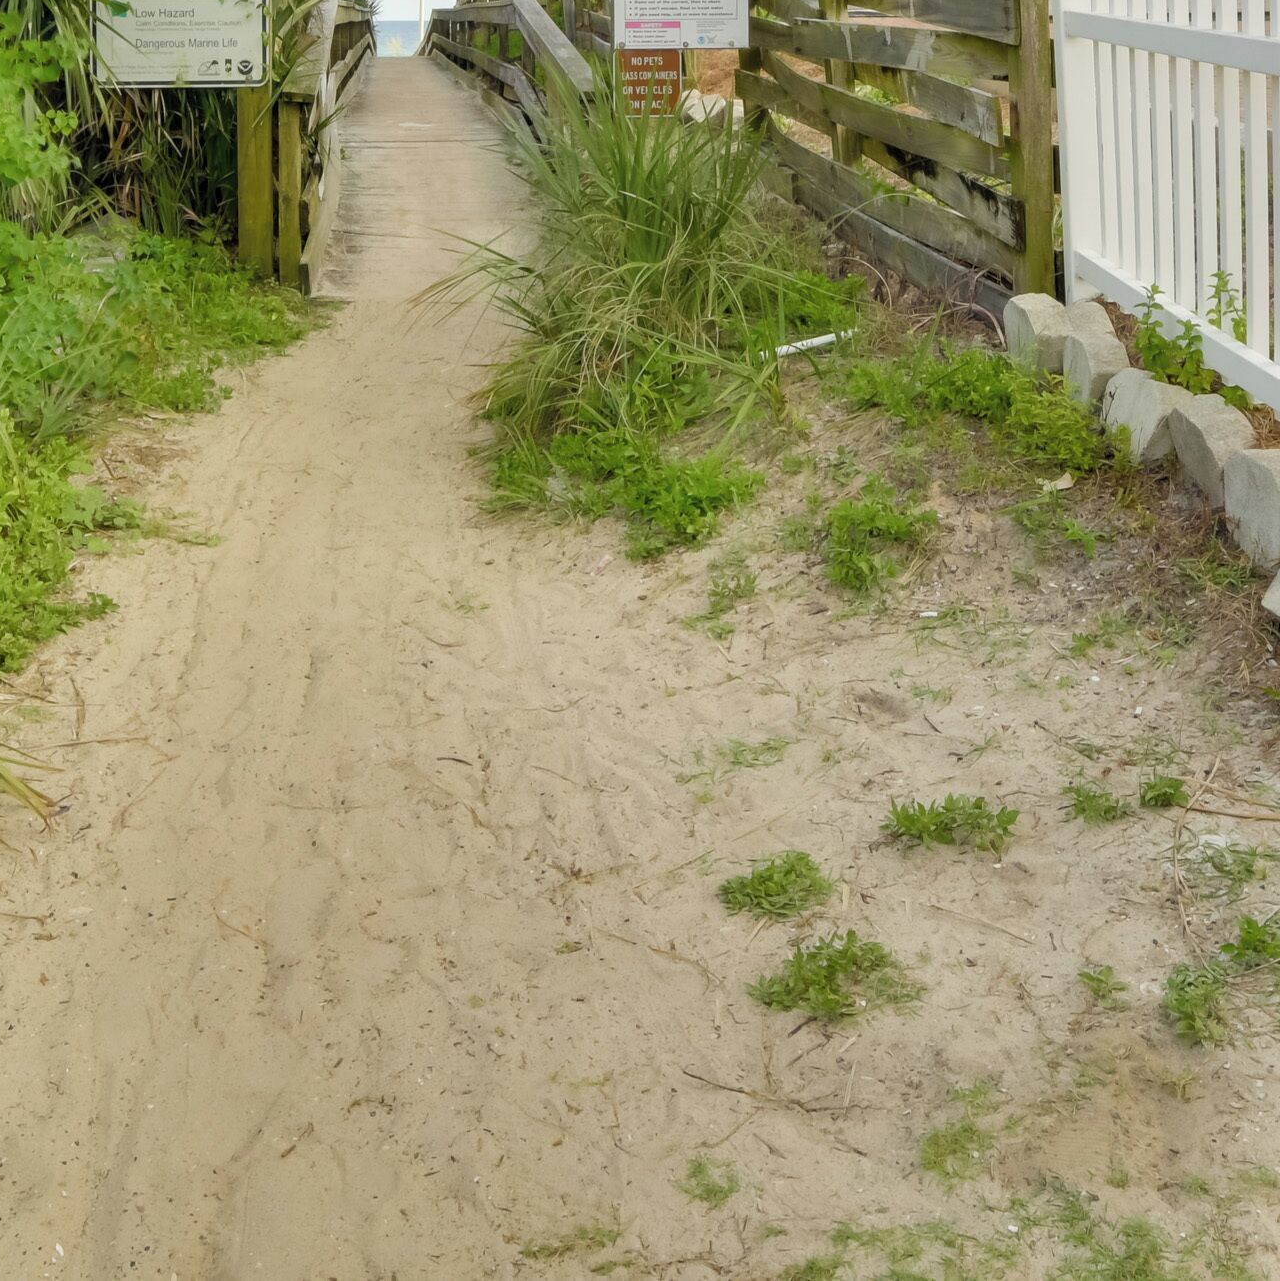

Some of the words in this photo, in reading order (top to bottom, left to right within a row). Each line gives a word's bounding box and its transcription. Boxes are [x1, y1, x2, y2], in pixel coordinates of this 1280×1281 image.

[135, 9, 155, 18] Low
[158, 9, 195, 18] Hazard
[135, 38, 185, 50] Dangerous
[188, 38, 219, 49] Marine
[222, 38, 238, 49] Life
[631, 56, 642, 66] NO
[644, 56, 663, 66] PETS
[621, 70, 638, 80] LASS
[639, 70, 677, 80] CONAINERS
[622, 85, 633, 95] OR
